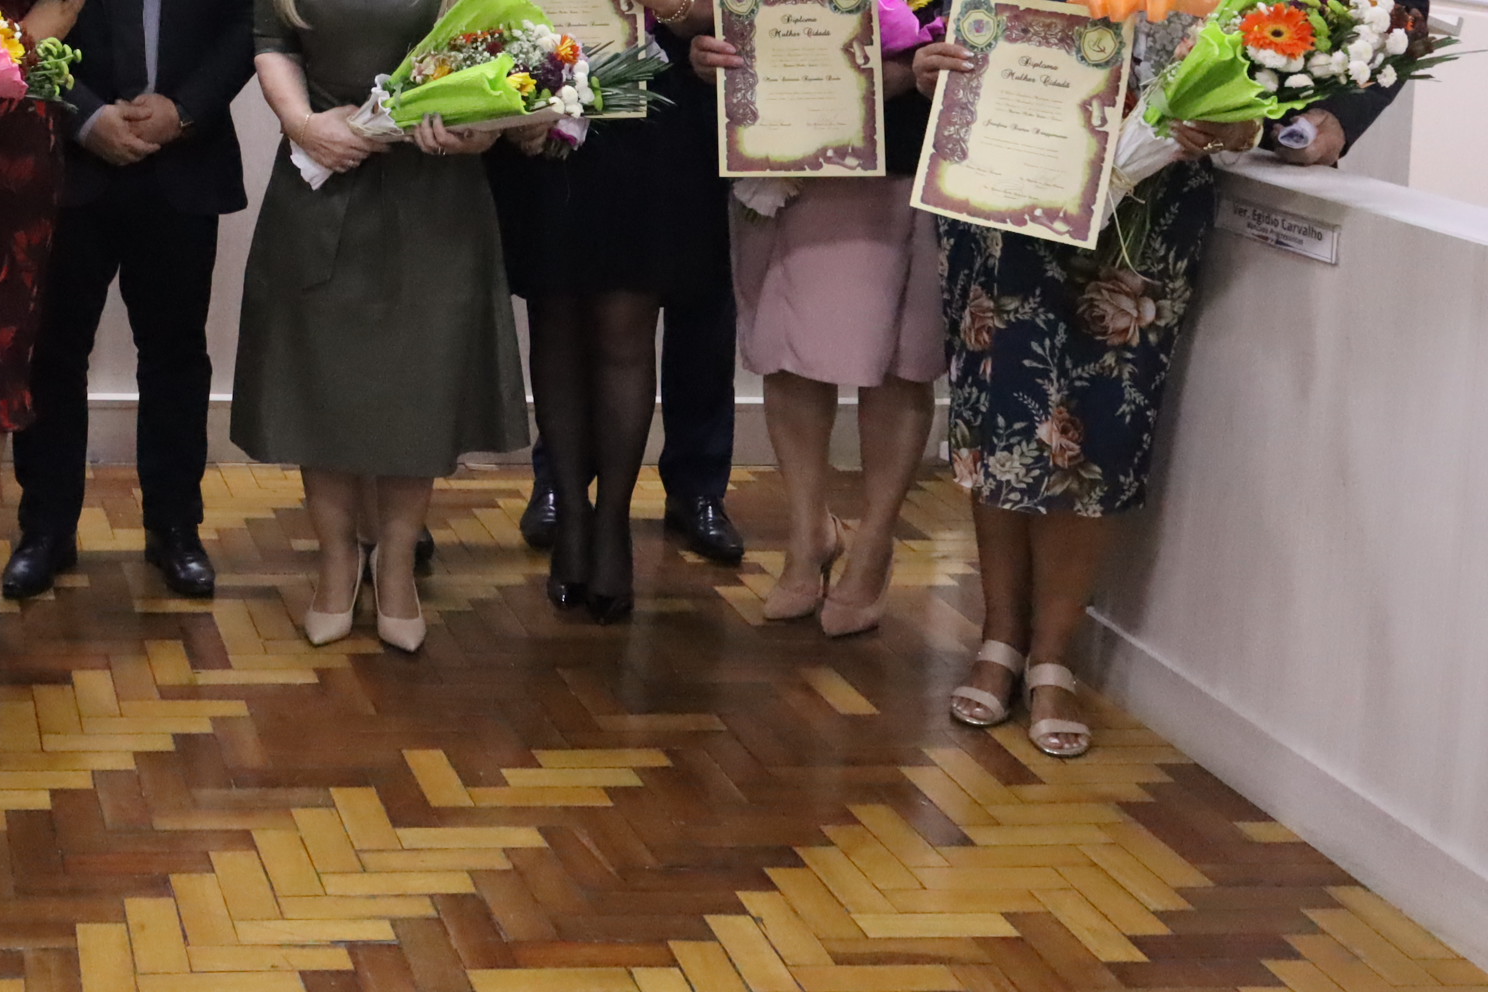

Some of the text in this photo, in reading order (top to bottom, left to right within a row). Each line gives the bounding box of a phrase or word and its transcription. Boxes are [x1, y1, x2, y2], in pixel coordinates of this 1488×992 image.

[780, 13, 818, 25] Diploma
[1018, 55, 1060, 71] Diploma
[1281, 217, 1323, 242] Carvalho
